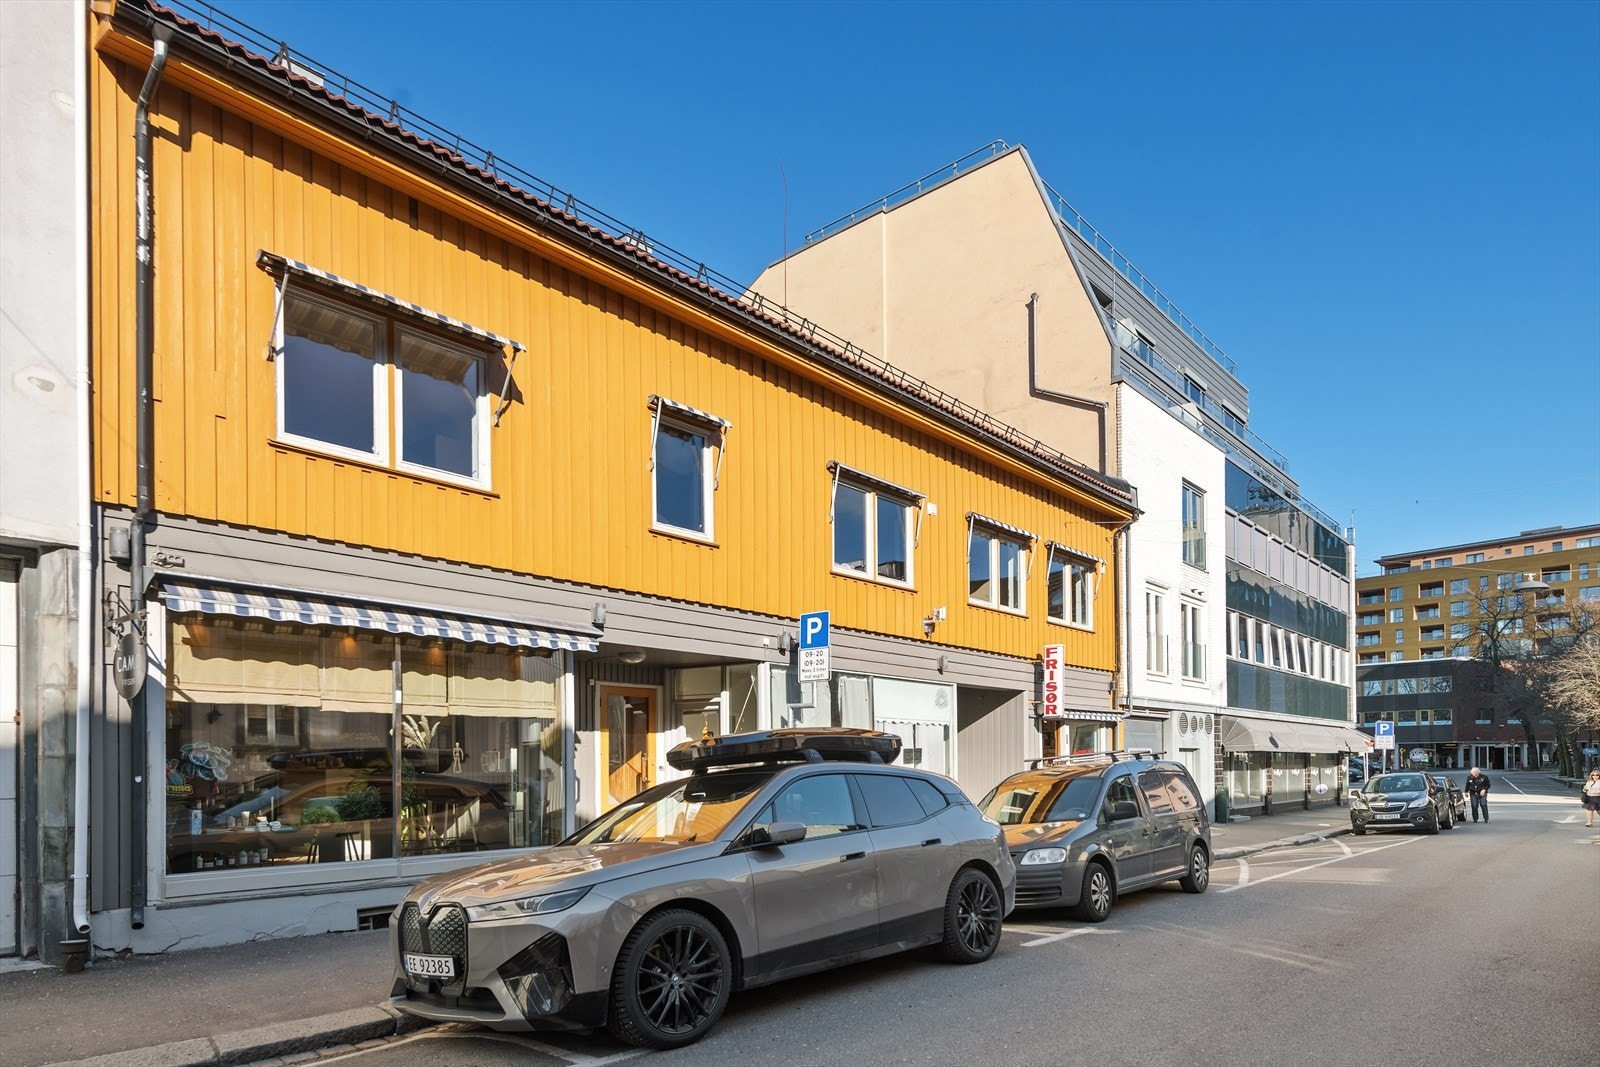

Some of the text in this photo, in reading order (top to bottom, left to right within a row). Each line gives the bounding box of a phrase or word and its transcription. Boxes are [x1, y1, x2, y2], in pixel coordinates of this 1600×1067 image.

[807, 617, 822, 645] P
[1045, 647, 1058, 715] FRISØR
[1380, 723, 1390, 735] P
[419, 958, 451, 974] 92385
